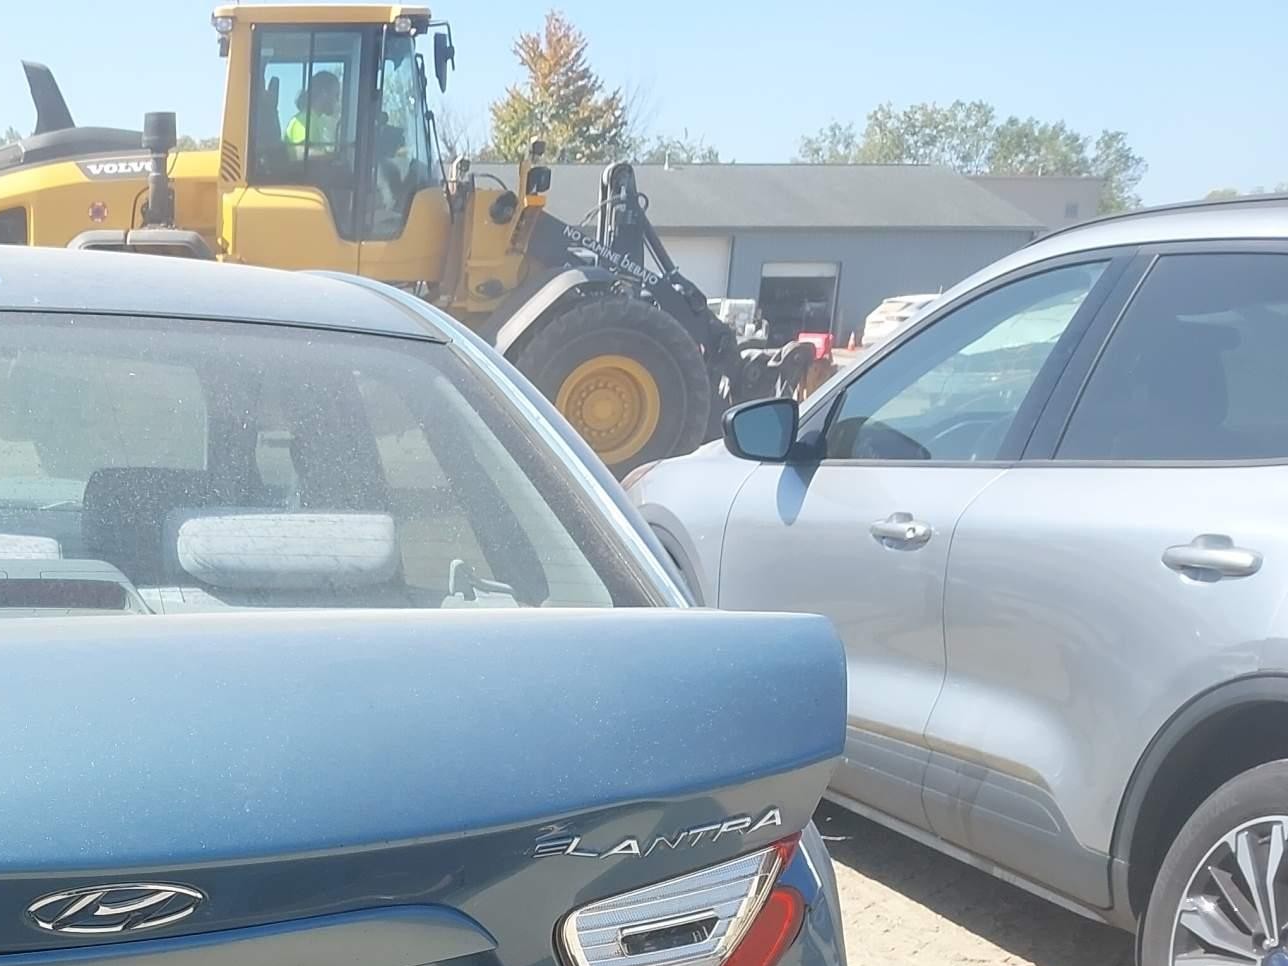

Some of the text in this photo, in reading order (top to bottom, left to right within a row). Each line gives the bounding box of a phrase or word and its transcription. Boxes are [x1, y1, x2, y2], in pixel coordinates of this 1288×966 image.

[562, 225, 582, 241] NO
[581, 236, 622, 265] CAMINE
[531, 807, 782, 859] ELANTRA
